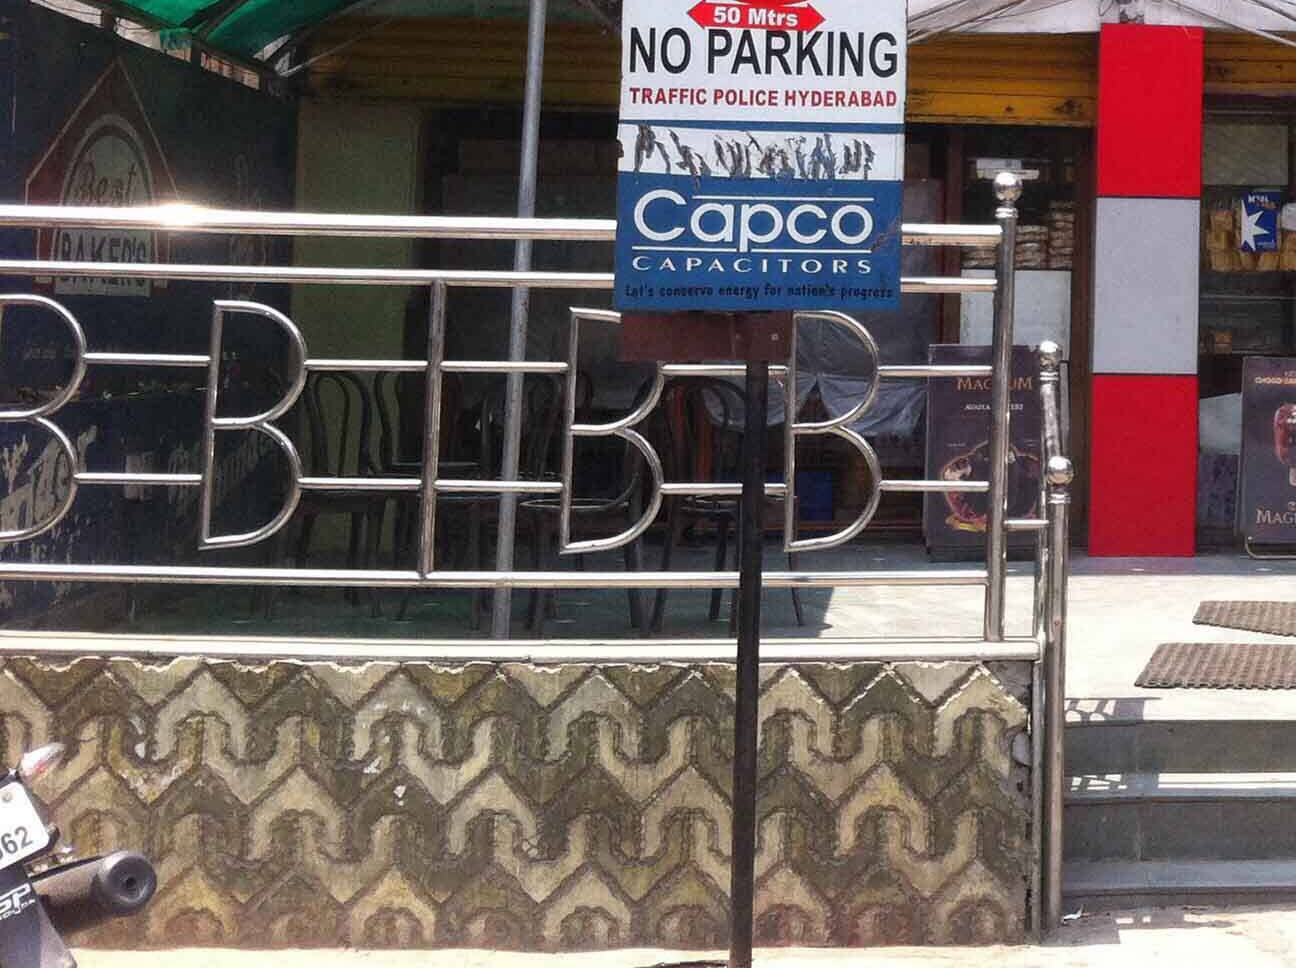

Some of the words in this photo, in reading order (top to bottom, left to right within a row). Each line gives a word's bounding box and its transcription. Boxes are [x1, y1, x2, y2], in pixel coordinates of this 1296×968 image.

[713, 6, 741, 25] 50
[749, 8, 798, 27] Mtrs
[629, 26, 691, 74] NO
[707, 28, 898, 78] PARKING
[630, 87, 707, 105] TRAFFIC
[713, 89, 778, 106] POLICE
[784, 90, 897, 107] HYDERABAD
[633, 188, 874, 252] Capco
[632, 255, 873, 274] CAPACITORS
[718, 285, 760, 299] energy
[765, 283, 783, 296] for
[956, 376, 1033, 392] MAGUM
[0, 826, 33, 860] 62
